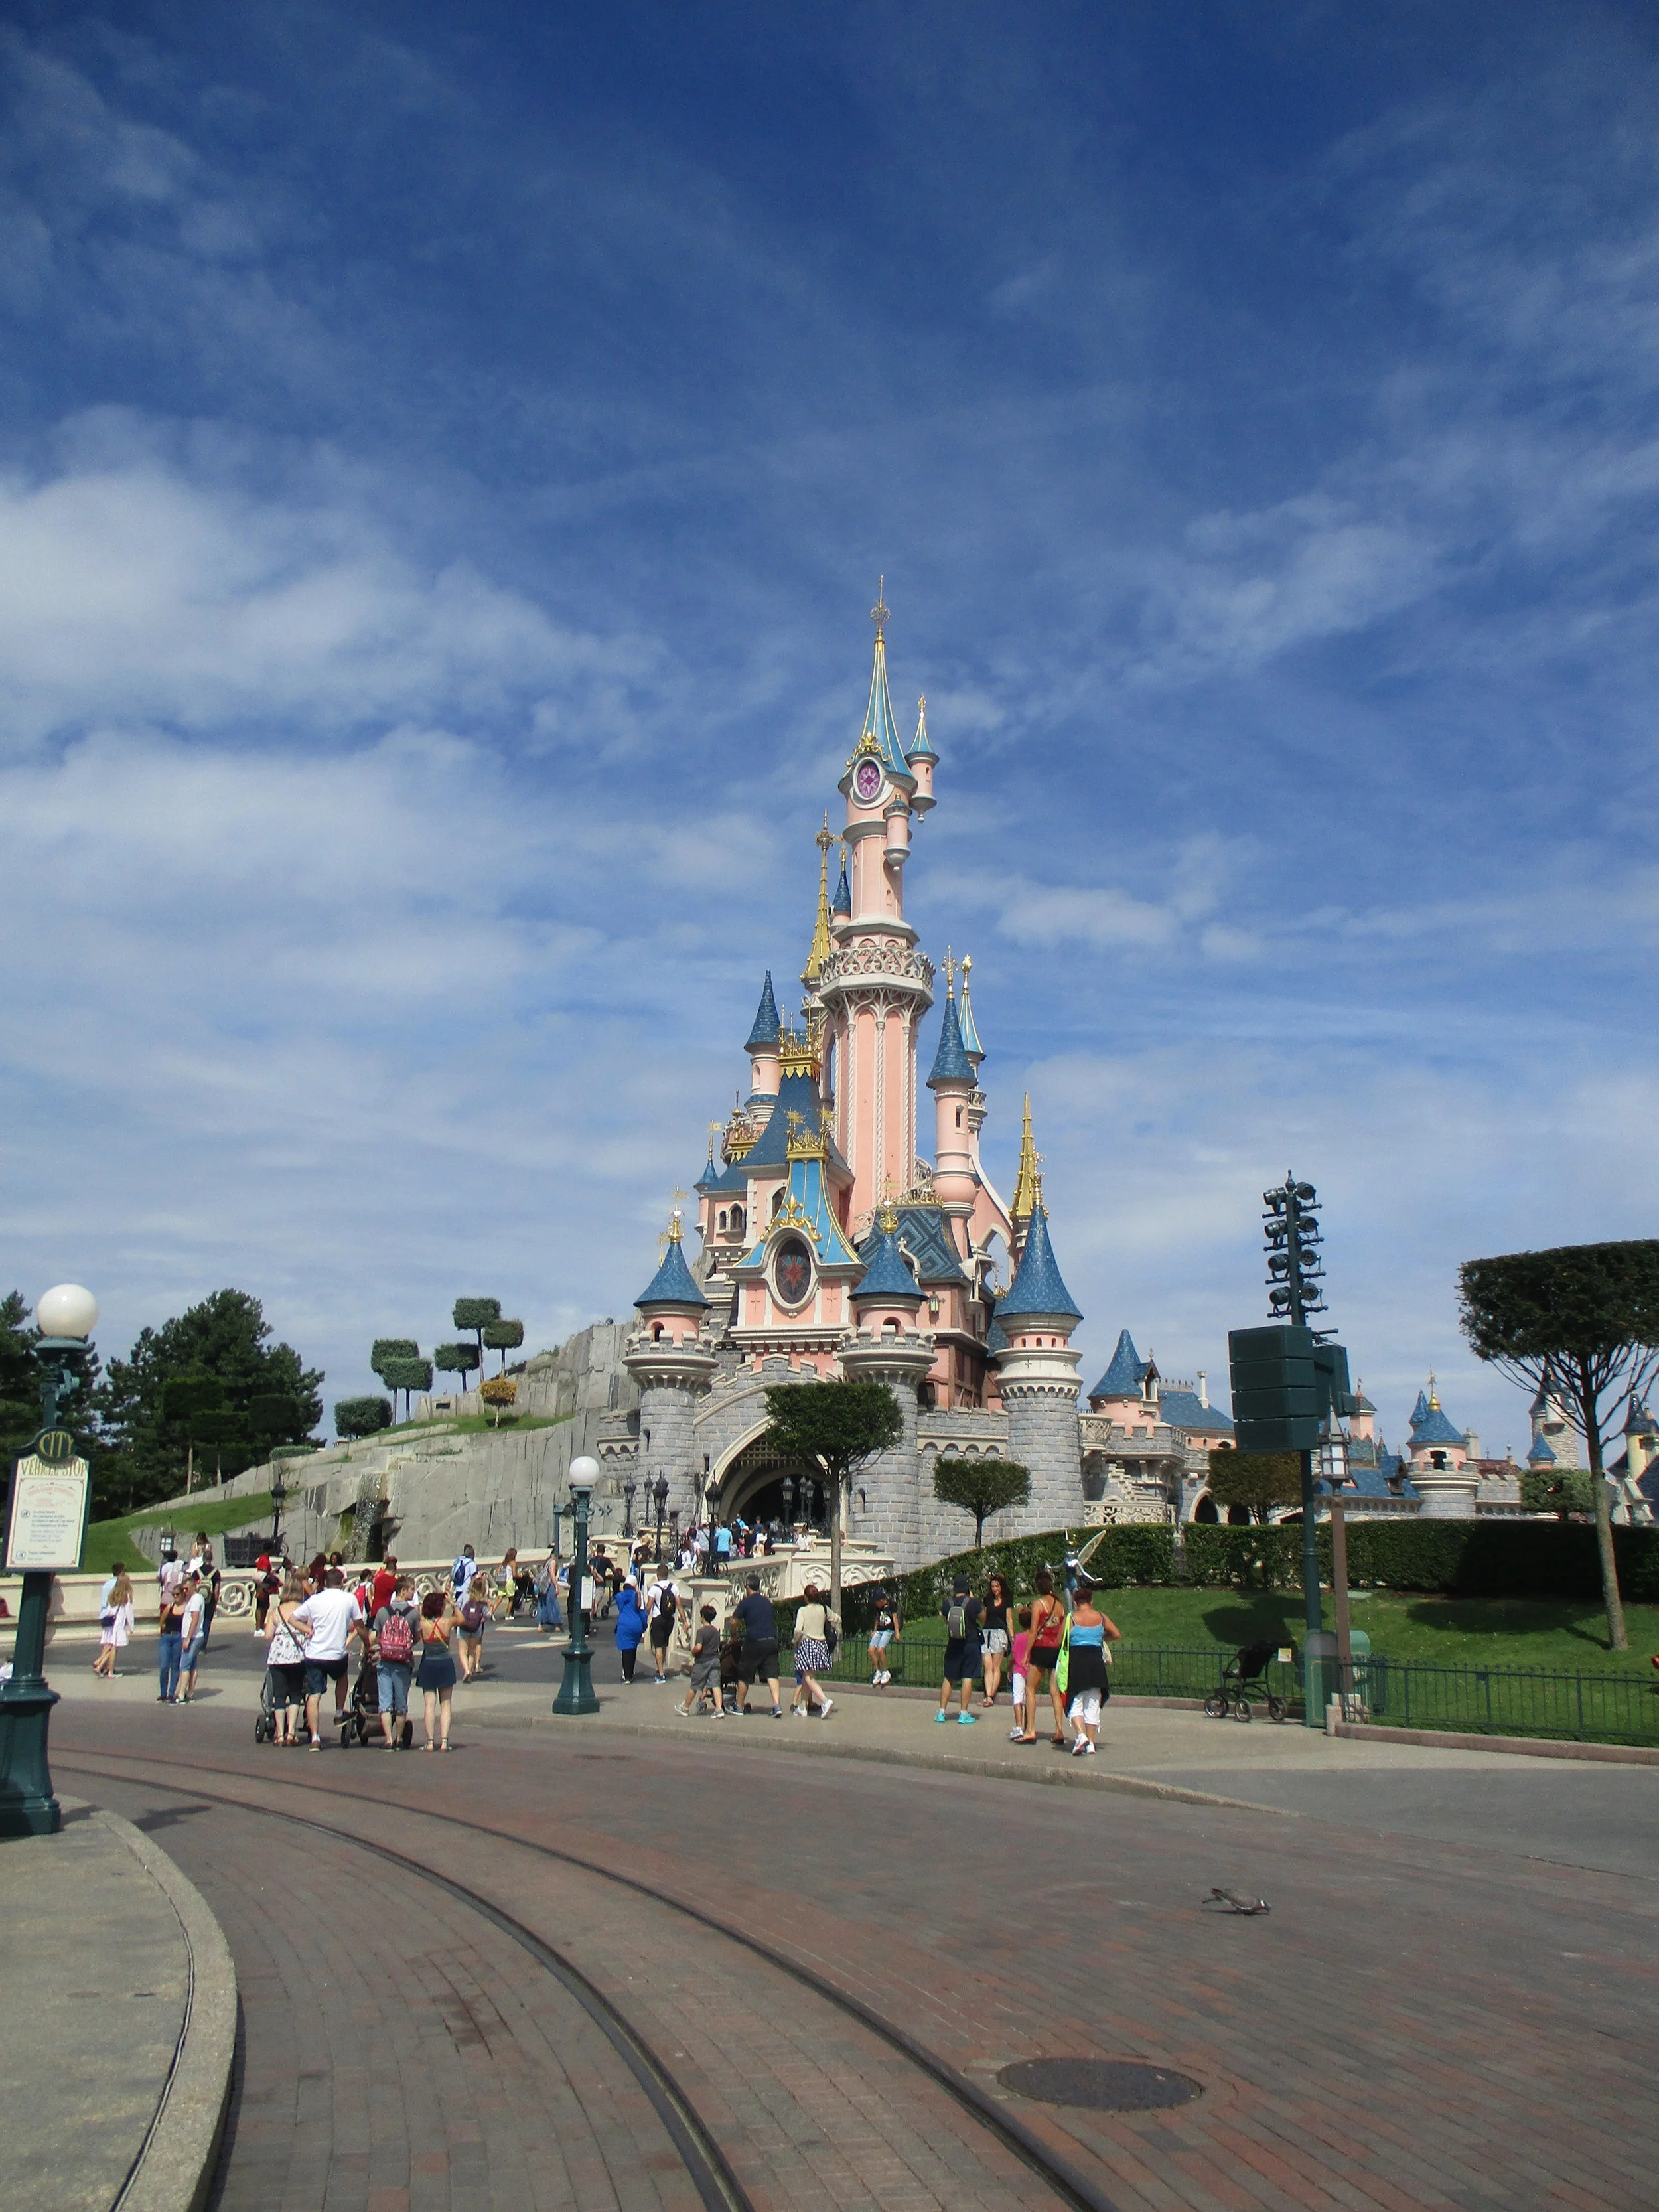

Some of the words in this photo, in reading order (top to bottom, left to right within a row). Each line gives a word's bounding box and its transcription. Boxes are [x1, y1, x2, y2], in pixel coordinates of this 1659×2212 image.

[39, 1431, 74, 1458] CITY
[21, 1459, 58, 1476] VEHICLE
[63, 1459, 87, 1477] STOP
